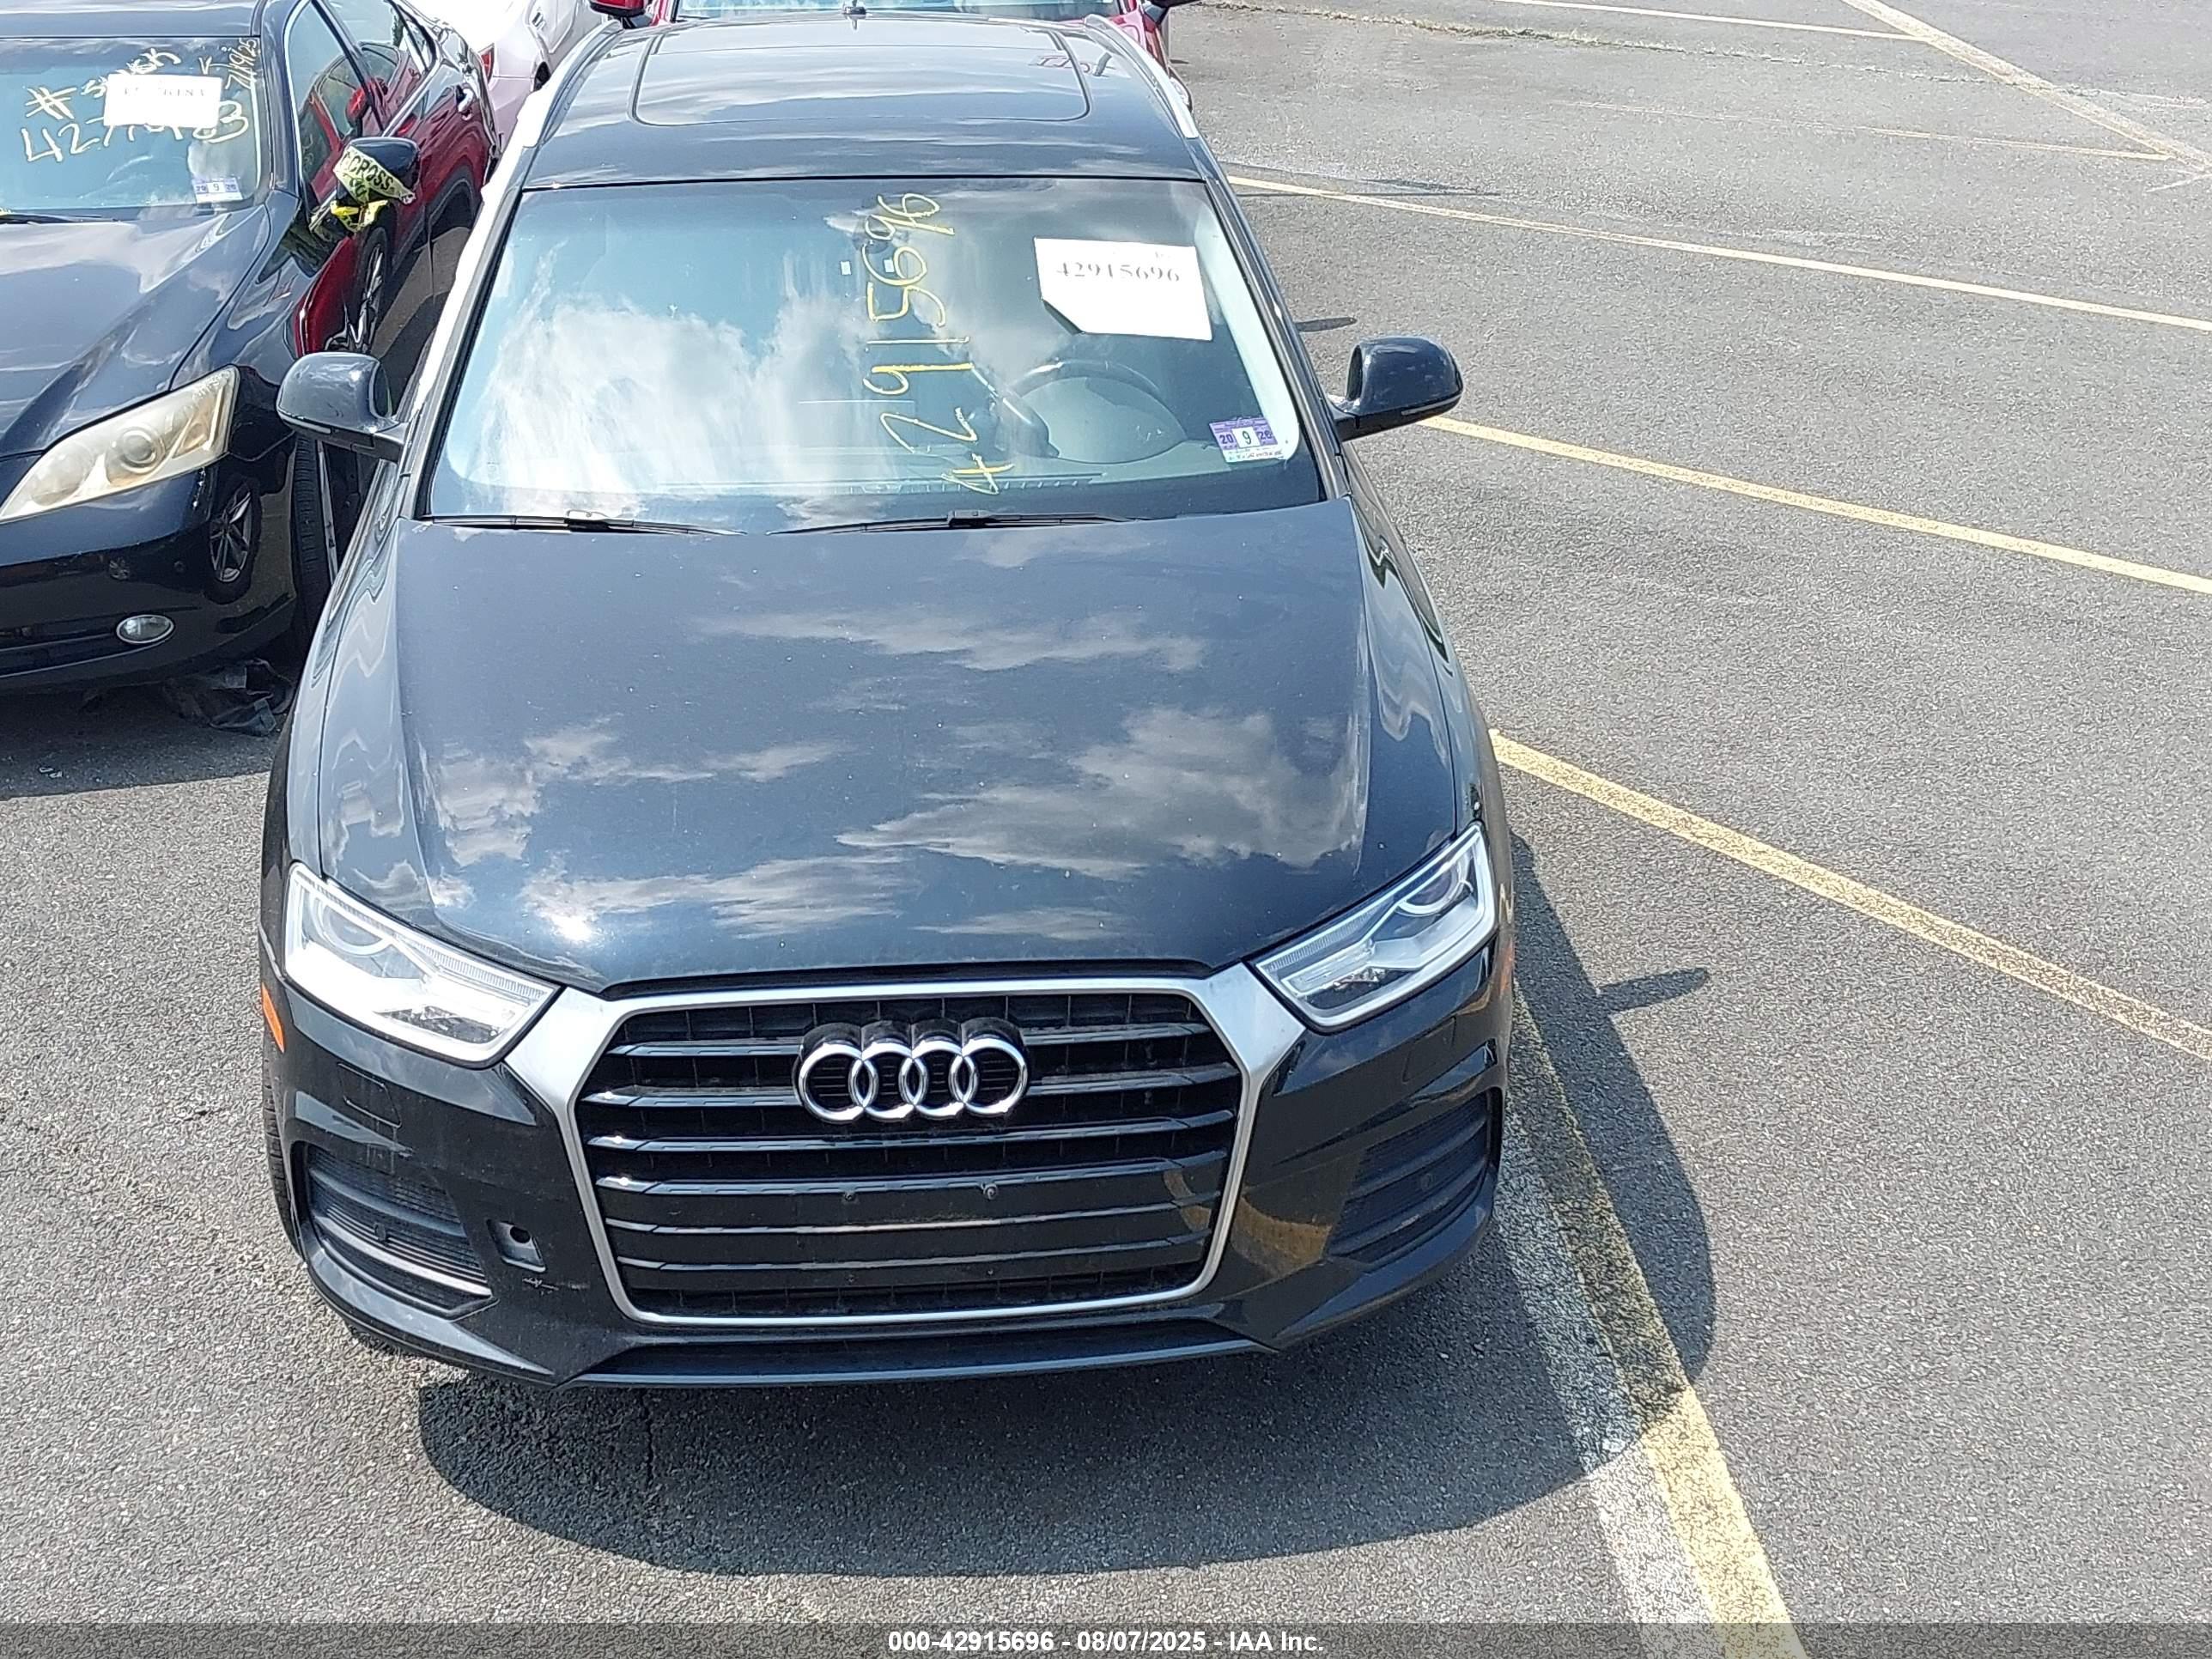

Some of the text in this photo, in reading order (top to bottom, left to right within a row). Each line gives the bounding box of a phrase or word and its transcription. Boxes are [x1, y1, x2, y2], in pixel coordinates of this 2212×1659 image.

[348, 155, 394, 191] CROSS
[213, 183, 220, 191] 9
[1056, 261, 1180, 283] 42915696
[862, 193, 1014, 495] 42915696
[1219, 434, 1234, 445] 20
[1242, 430, 1252, 445] 9
